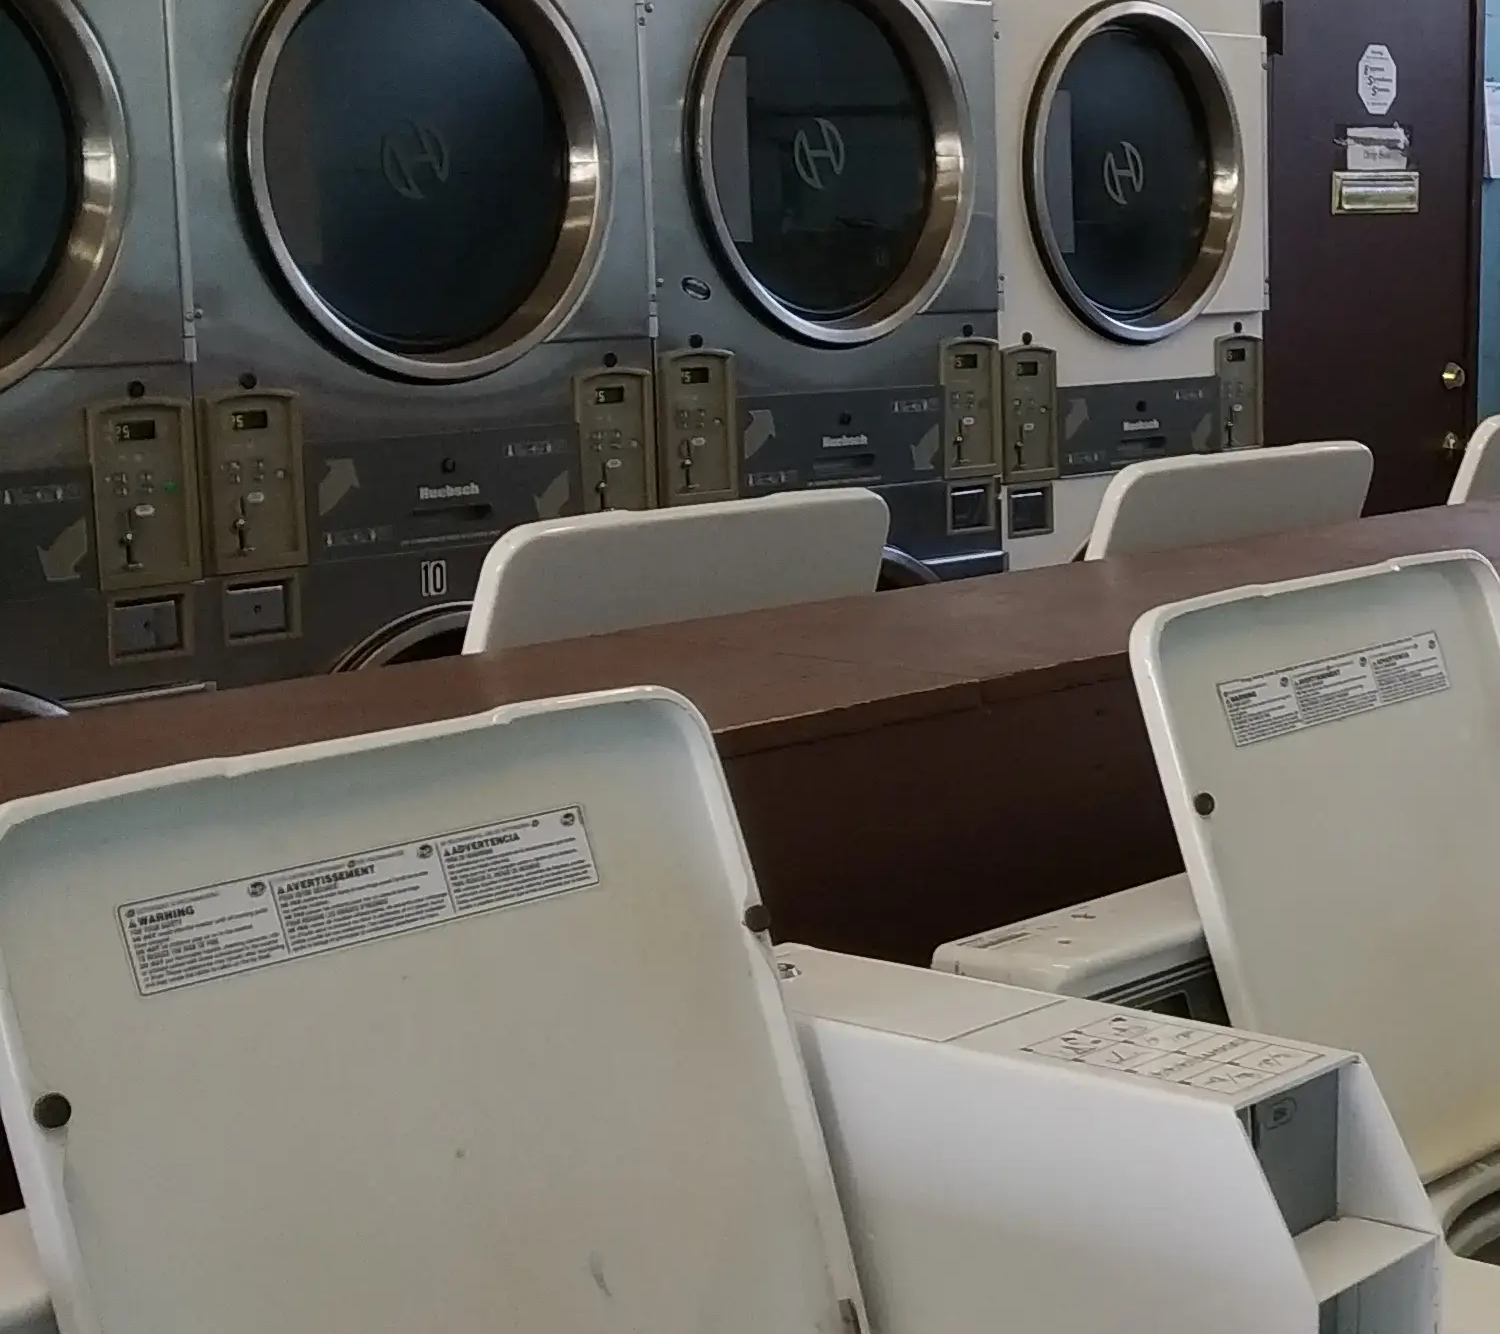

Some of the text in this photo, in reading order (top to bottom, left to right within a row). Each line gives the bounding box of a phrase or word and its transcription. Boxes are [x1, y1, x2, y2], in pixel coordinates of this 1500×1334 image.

[423, 562, 444, 595] 10
[451, 833, 521, 856] ADVERTENCIA
[286, 864, 375, 893] AVERTISSEMENT
[138, 905, 196, 926] WARNING
